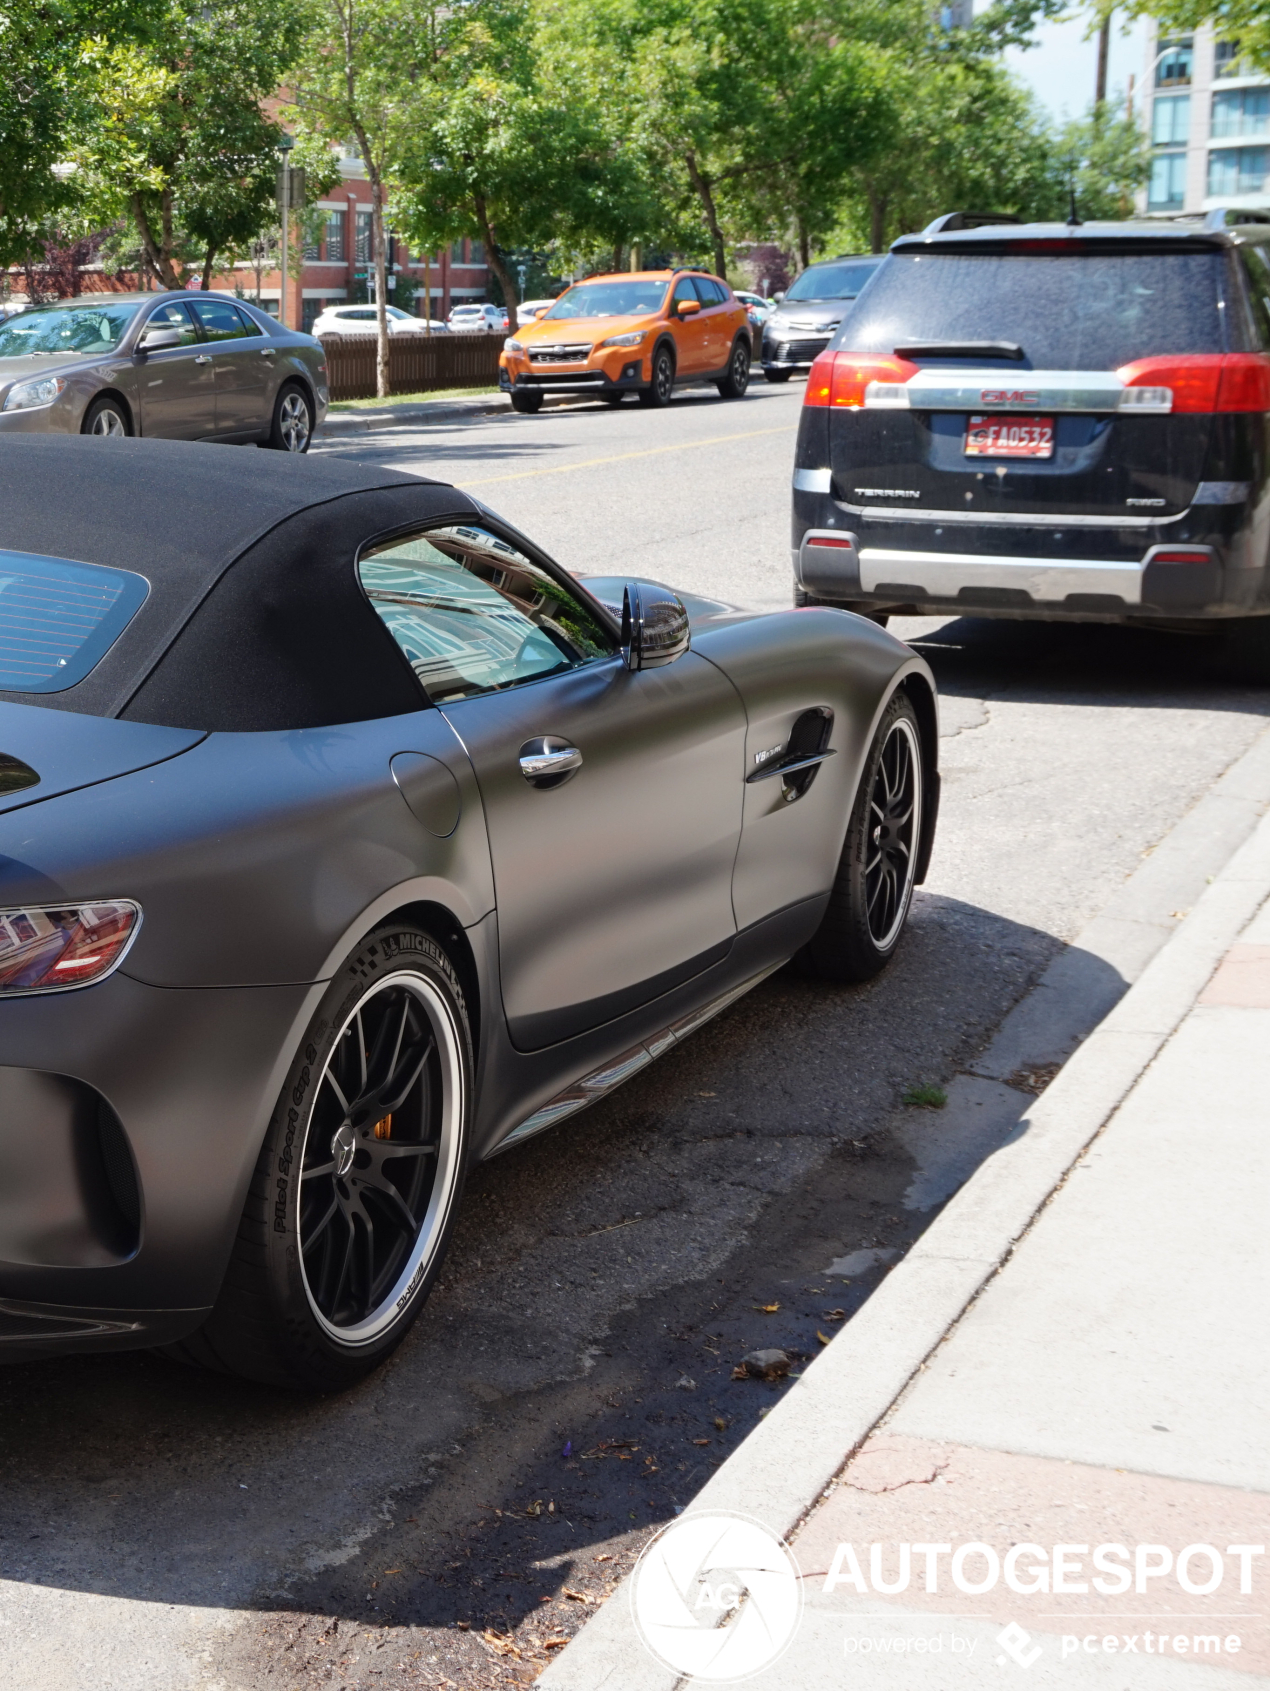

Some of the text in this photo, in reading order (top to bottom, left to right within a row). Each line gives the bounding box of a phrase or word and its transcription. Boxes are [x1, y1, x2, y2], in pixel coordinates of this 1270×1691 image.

[981, 390, 1038, 403] GMC
[854, 488, 920, 498] TERRAIN
[1126, 498, 1166, 506] AWD
[399, 934, 451, 975] MICHELIN
[274, 1043, 317, 1234] Pilot Sport Cup 2
